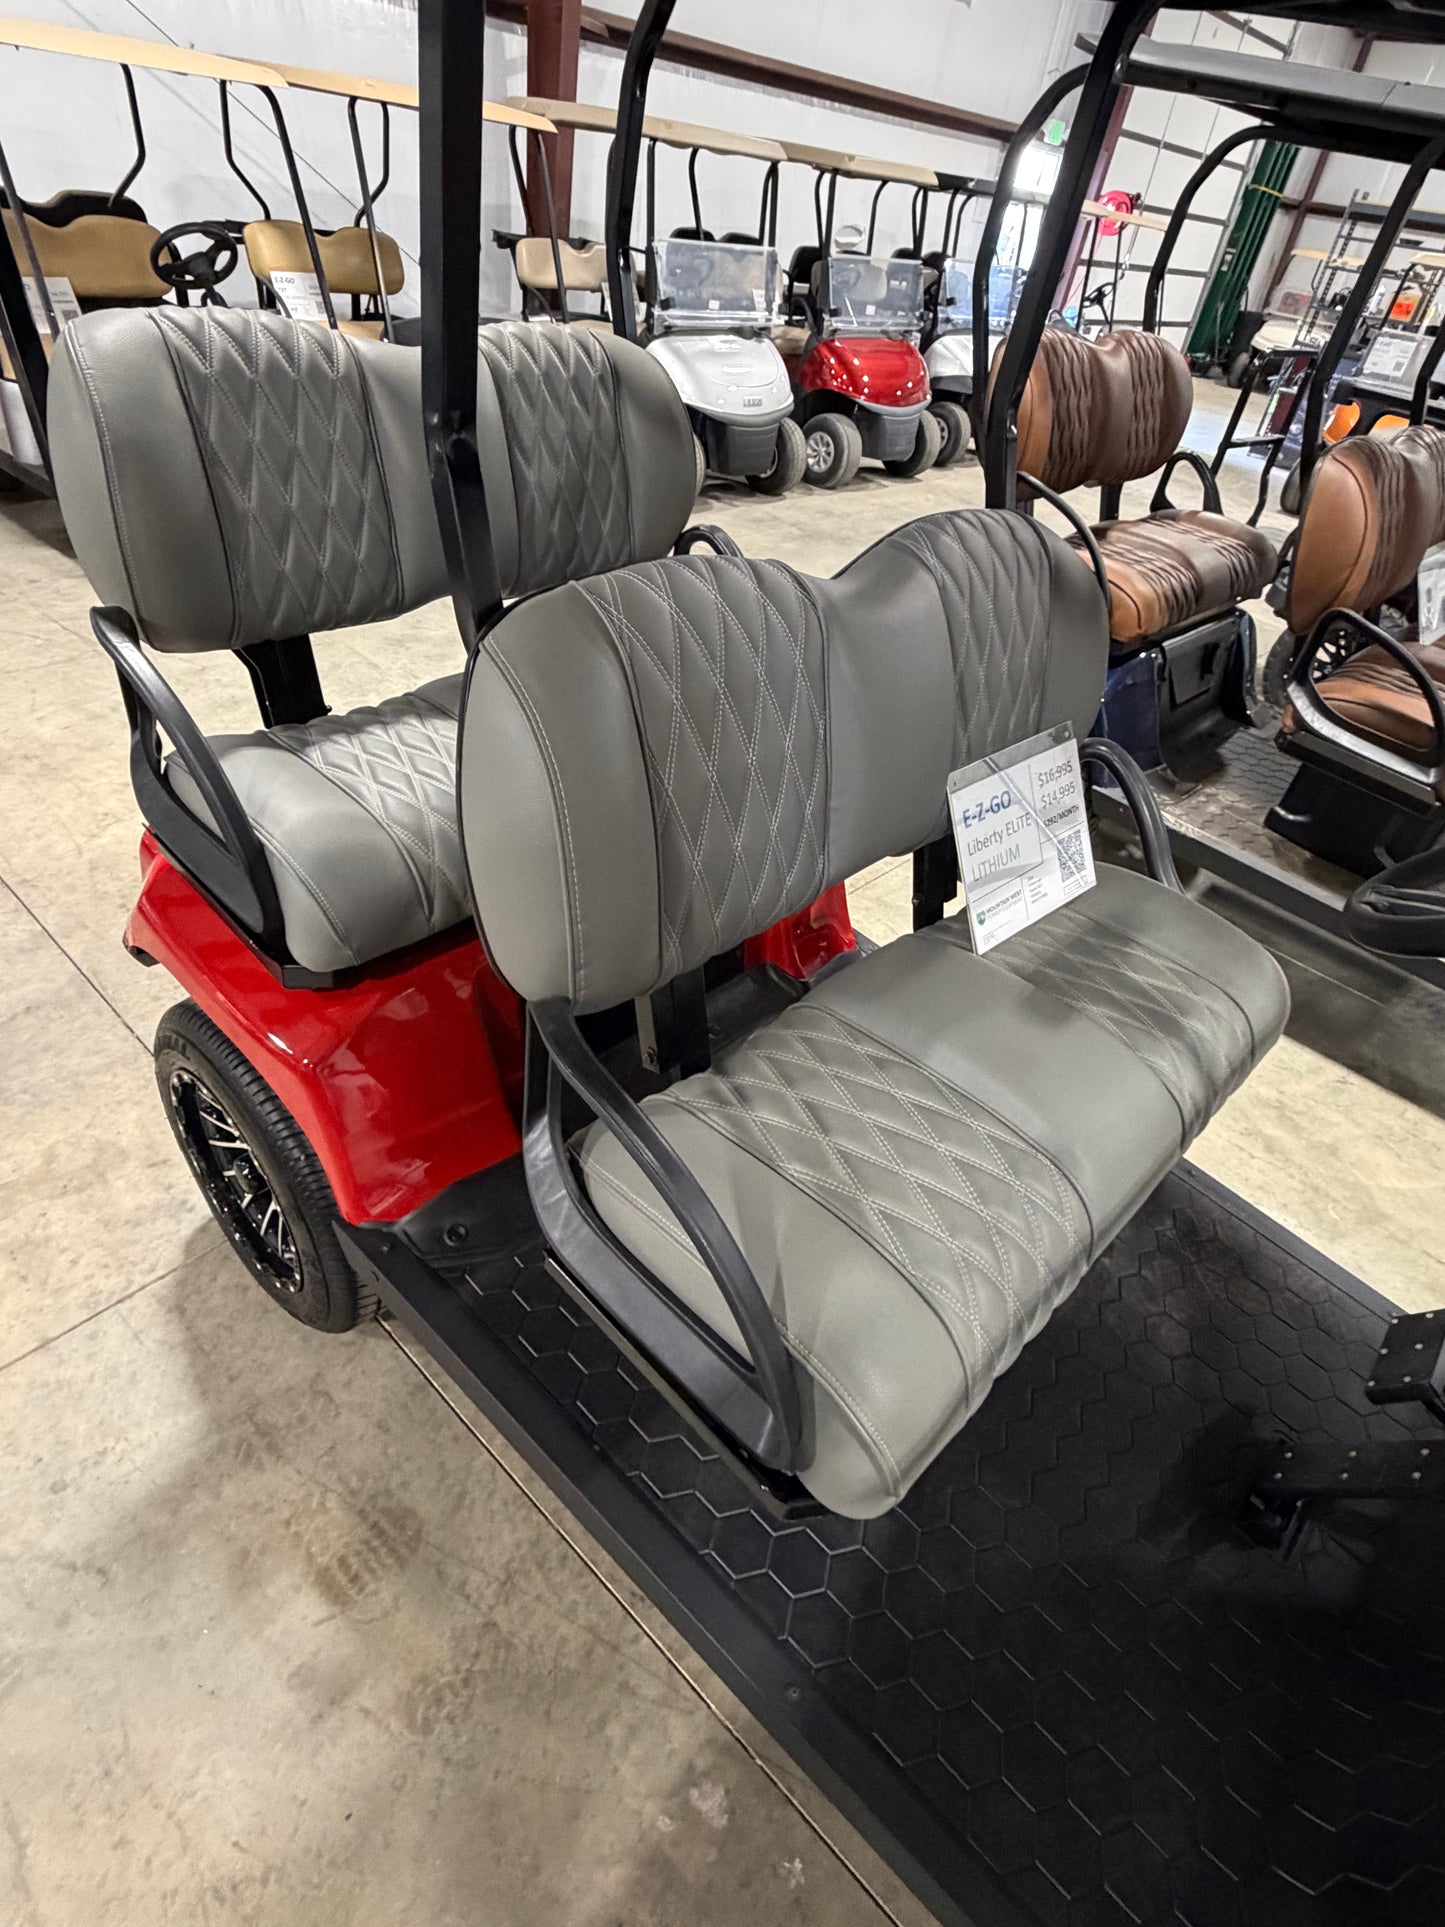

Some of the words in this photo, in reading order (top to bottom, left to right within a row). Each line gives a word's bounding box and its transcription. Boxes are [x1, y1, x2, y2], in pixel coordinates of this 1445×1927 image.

[1037, 760, 1073, 789] $16,995
[963, 790, 1012, 828] E-Z-GO
[1041, 781, 1076, 810] $14,995
[967, 829, 1004, 856] Liberty
[971, 844, 1021, 882] LITHIUM
[986, 897, 1010, 914] MOUNTAIN
[1010, 889, 1022, 900] WEST
